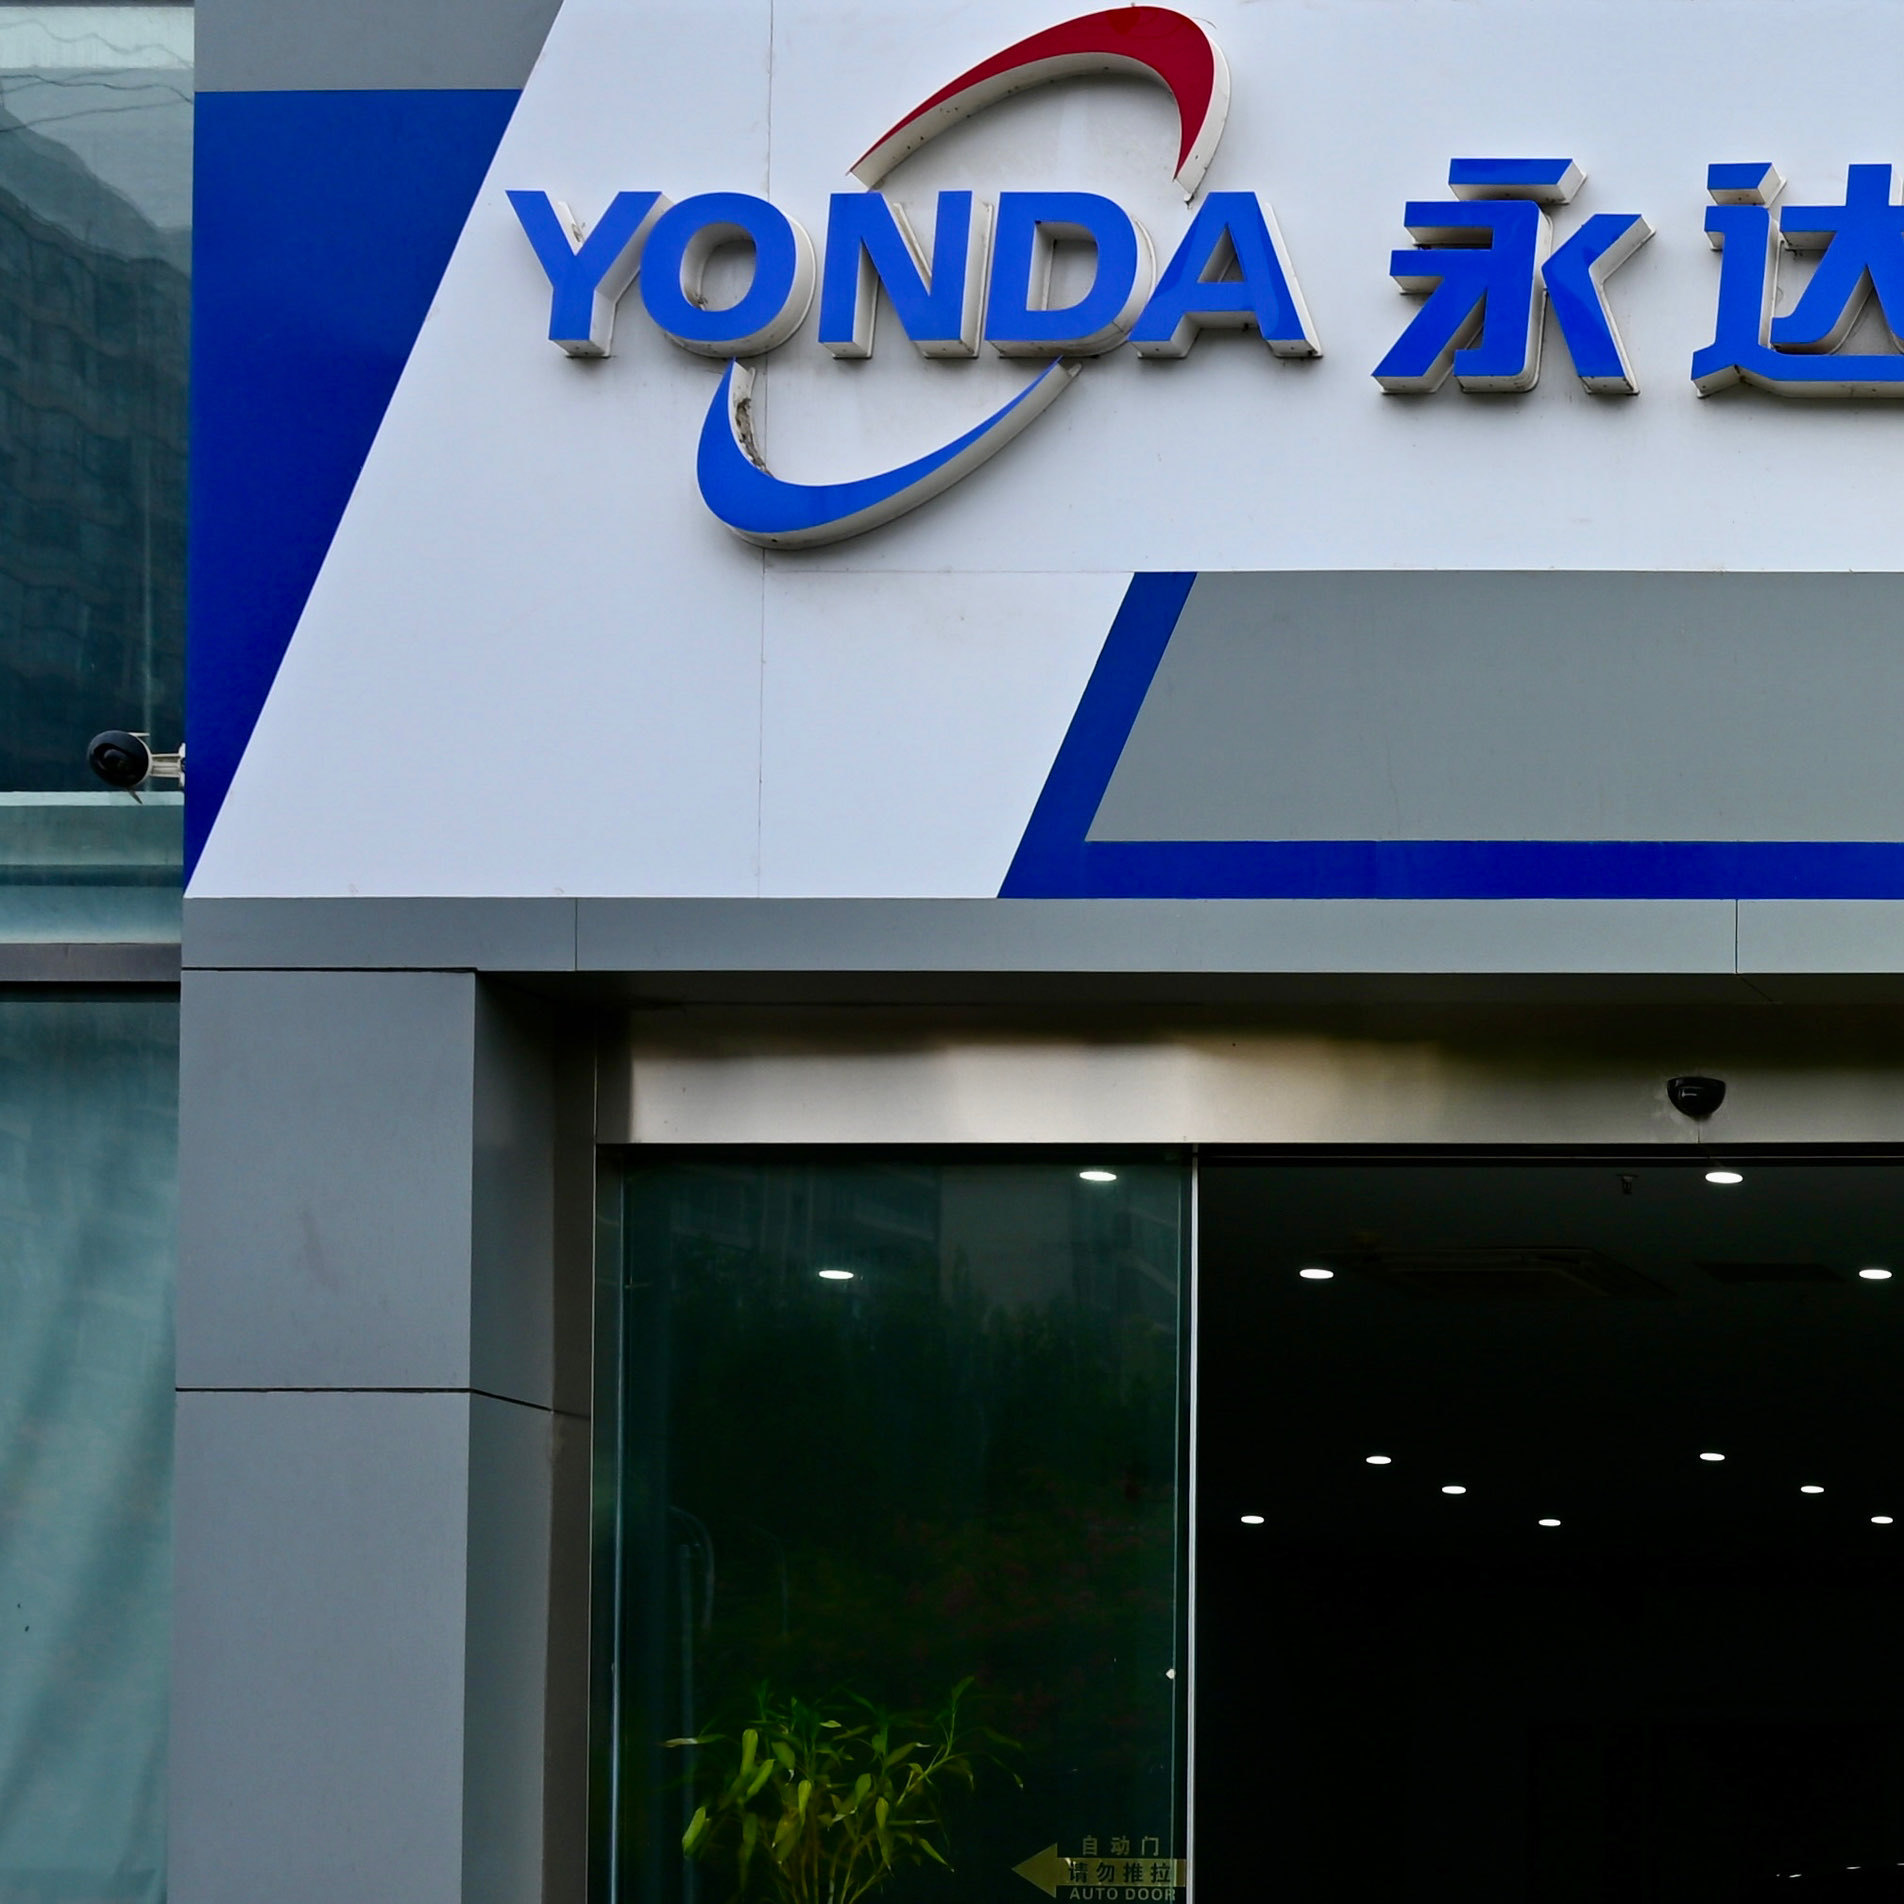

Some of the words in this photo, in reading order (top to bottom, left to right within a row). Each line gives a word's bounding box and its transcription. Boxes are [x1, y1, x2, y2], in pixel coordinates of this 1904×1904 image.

[505, 189, 1322, 359] YONDA
[1082, 1835, 1160, 1857] 自动门
[1068, 1862, 1172, 1884] 请勿推拉
[1069, 1887, 1119, 1901] AUTO
[1125, 1888, 1176, 1901] DOOR
